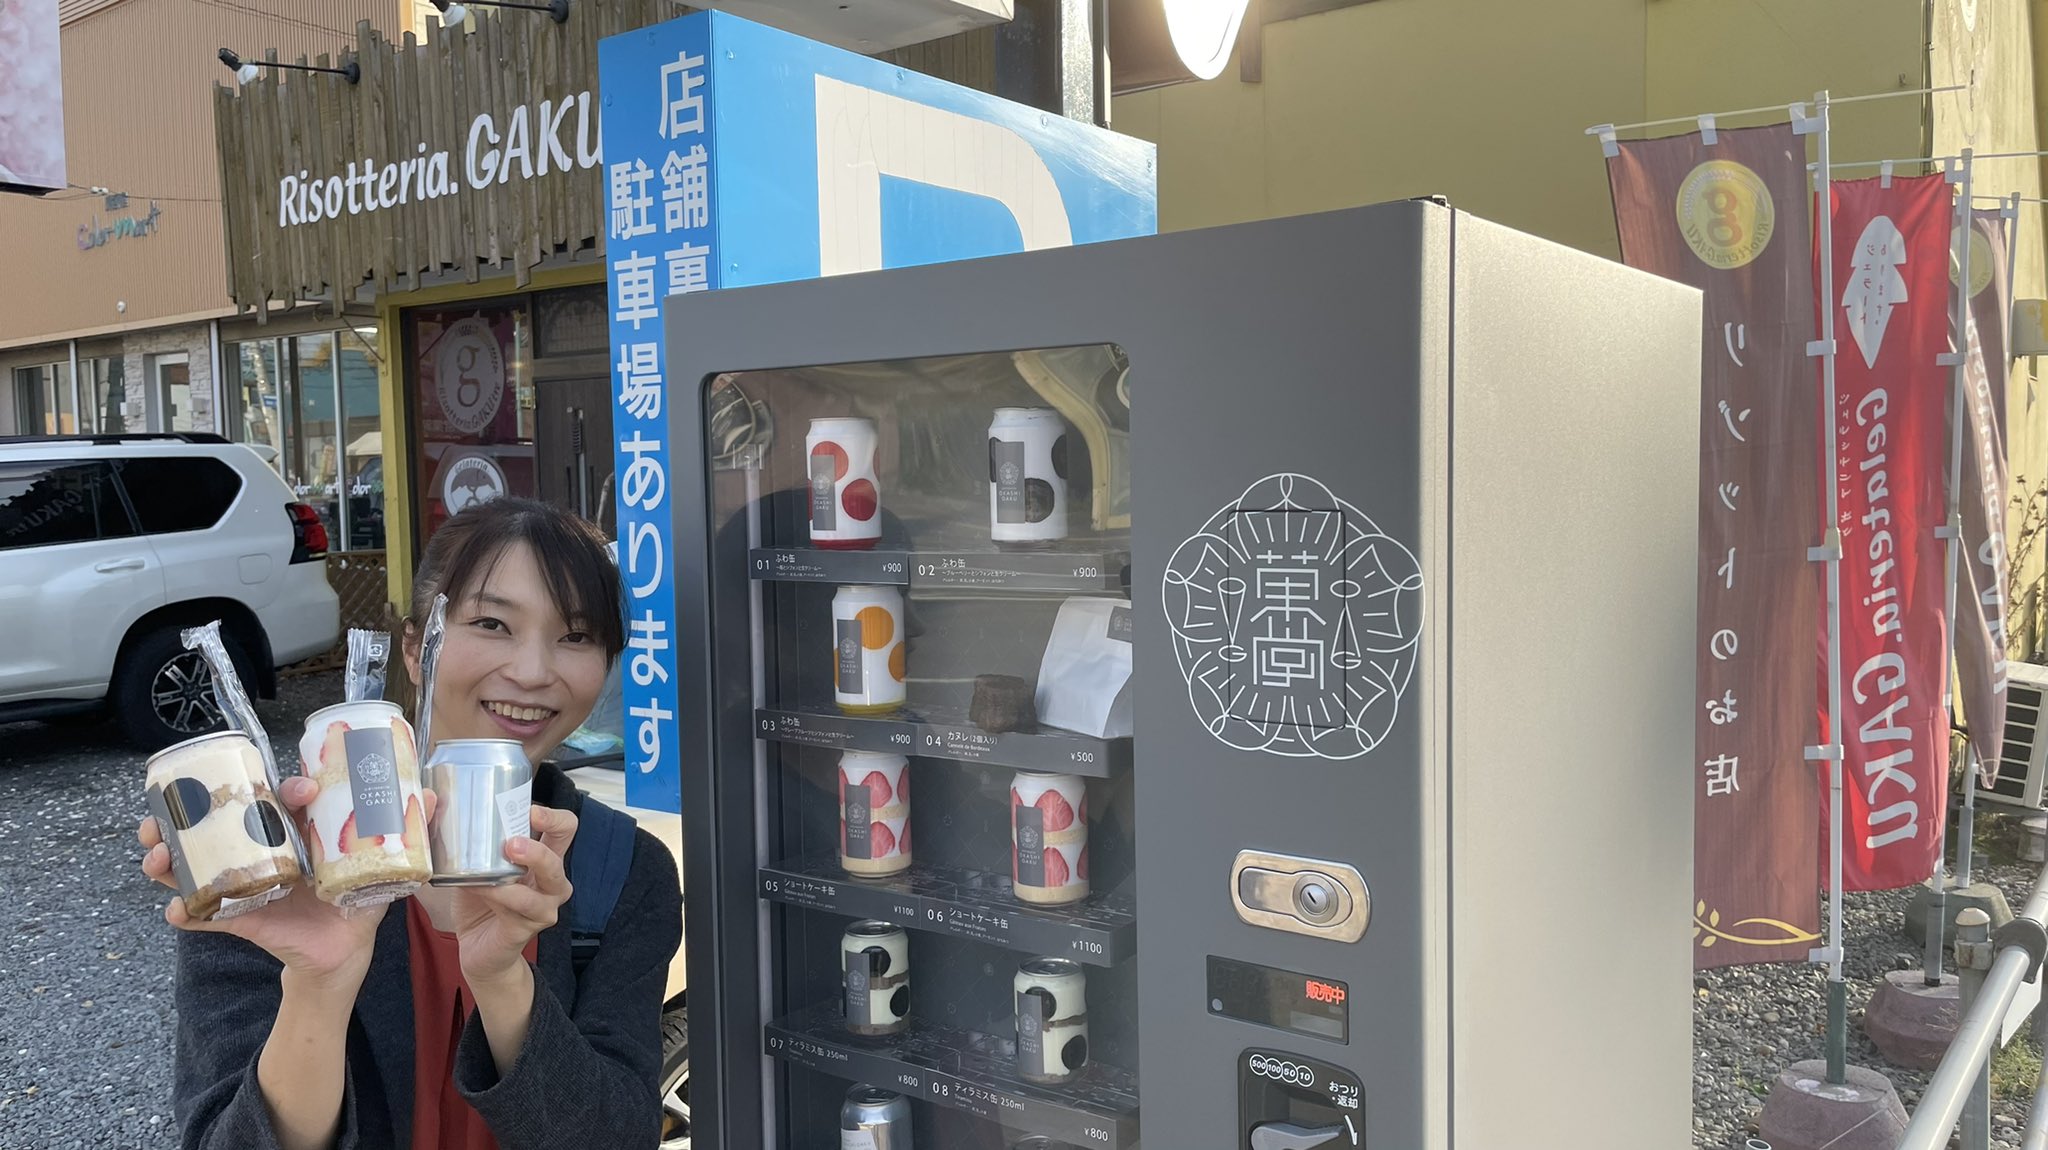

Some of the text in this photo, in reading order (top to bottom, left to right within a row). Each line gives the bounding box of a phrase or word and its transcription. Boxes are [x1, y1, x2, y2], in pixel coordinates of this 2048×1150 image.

[279, 91, 603, 227] Risotteria. GAKU
[610, 158, 673, 773] 駐車場あります
[757, 559, 770, 570] 01
[882, 563, 902, 573] ¥900
[918, 558, 966, 576] 02 ふわ缶
[1073, 567, 1097, 578] ¥900
[762, 719, 776, 731] 03
[890, 734, 911, 745] ¥900
[926, 735, 942, 747] 04
[1070, 752, 1094, 763] ¥500
[360, 791, 396, 800] OKASHI
[765, 878, 836, 896] 05 ショートケーキ缶
[894, 905, 914, 916] ¥1100
[927, 908, 1009, 929] 06 ショートケーキ缶
[1072, 940, 1102, 954] ¥1100
[1306, 980, 1344, 1005] 販売中
[770, 1037, 784, 1049] 07
[788, 1038, 824, 1056] ティラミス缶
[826, 1050, 848, 1061] 250ml
[1251, 1059, 1310, 1081] 500 100 50 10
[898, 1074, 918, 1087] ¥800
[1329, 1081, 1358, 1097] おつり
[933, 1082, 949, 1096] 08
[954, 1082, 998, 1105] ティラミス缶
[1000, 1097, 1025, 1111] 250ml
[1084, 1127, 1108, 1142] ¥800
